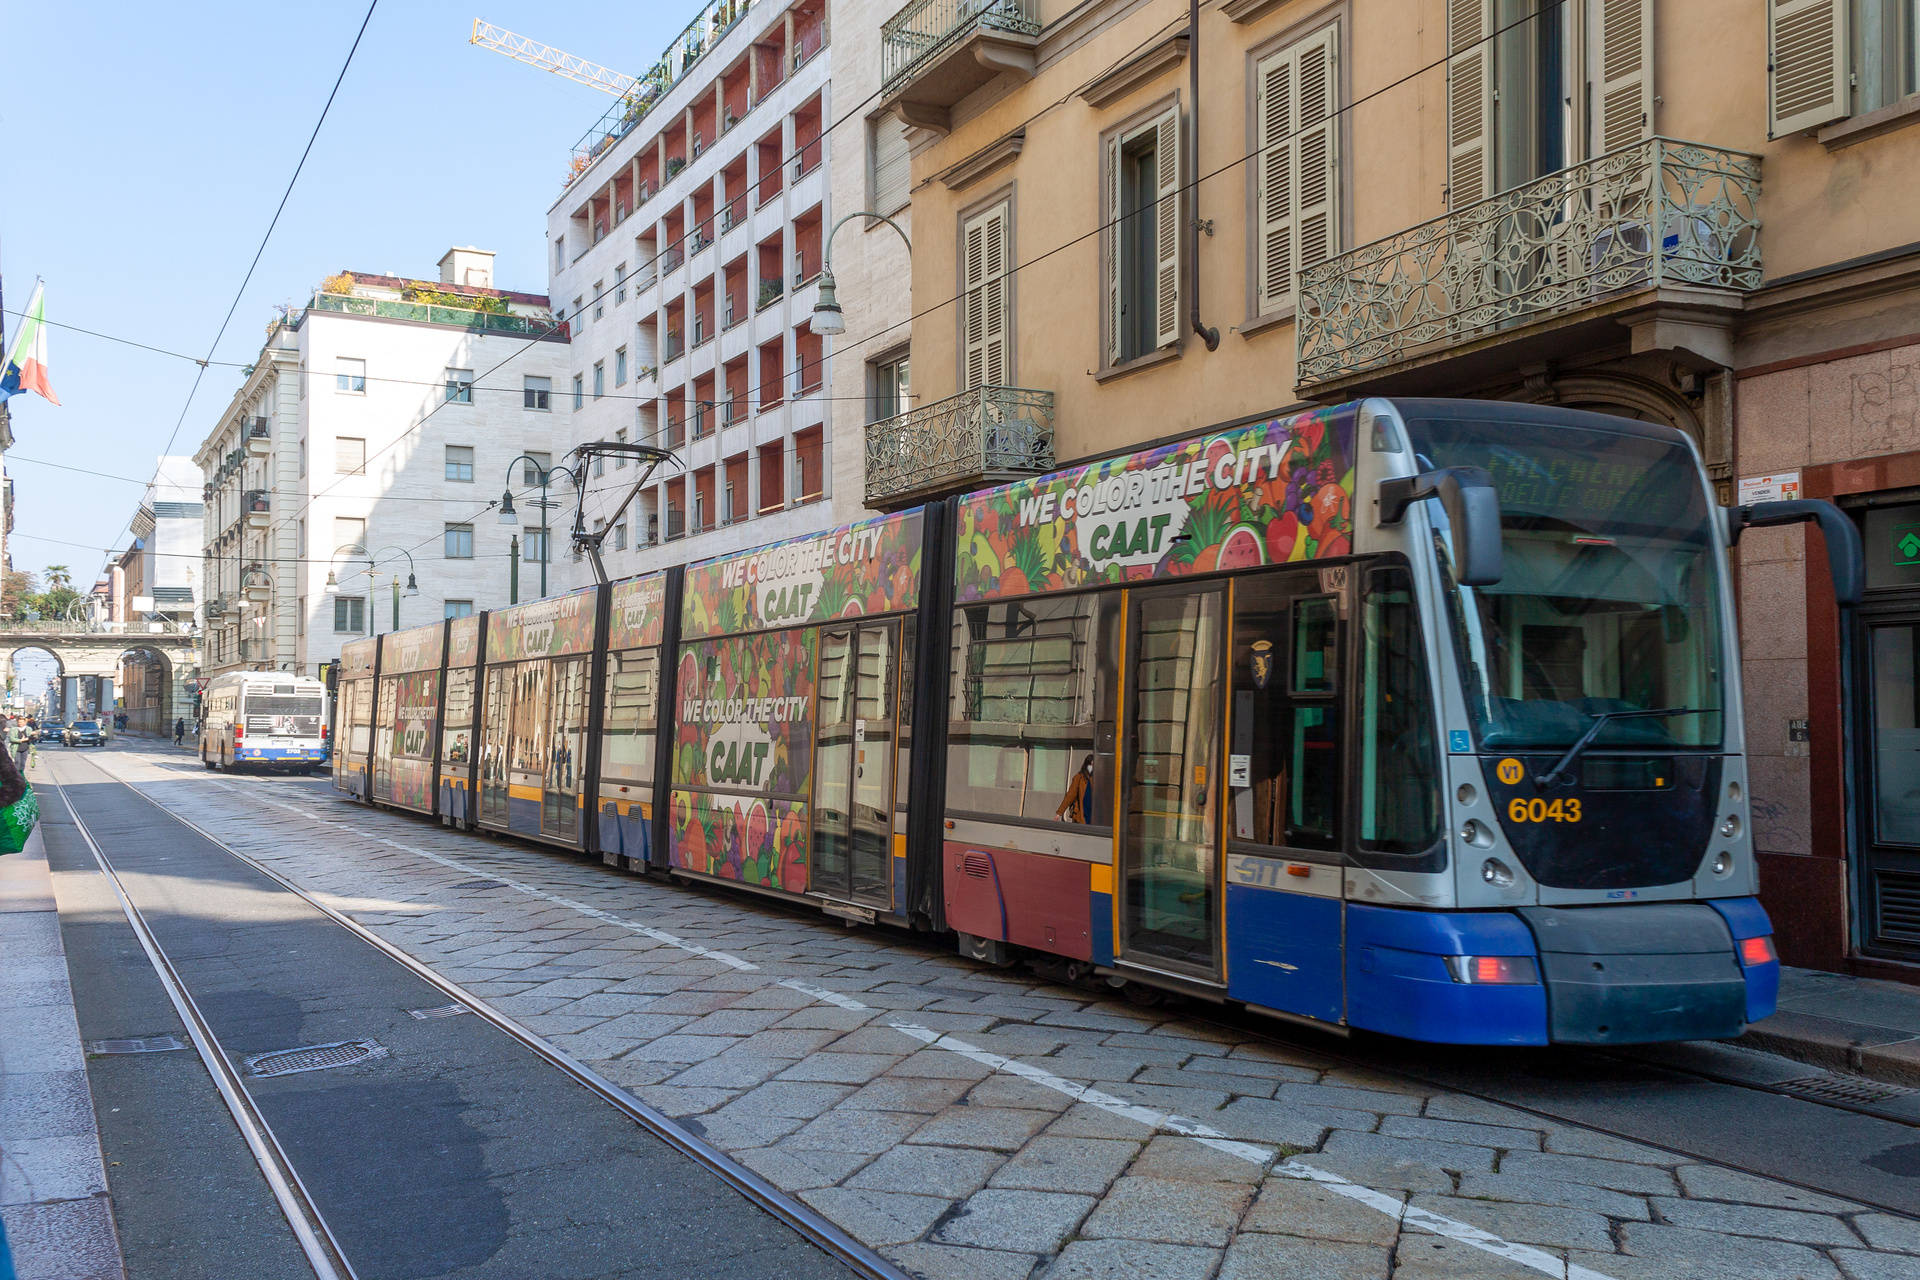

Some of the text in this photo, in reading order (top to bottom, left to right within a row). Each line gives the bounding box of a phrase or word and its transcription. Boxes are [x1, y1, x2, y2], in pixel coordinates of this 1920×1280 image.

[1018, 439, 1292, 527] WE COLOR THE CITY
[1488, 454, 1647, 487] FALCHERA
[1089, 513, 1171, 562] CAAT
[722, 525, 884, 589] WE COLOR THE CITY
[506, 609, 519, 629] WE
[560, 595, 582, 619] CITY
[763, 583, 813, 621] CAAT
[526, 629, 550, 654] CAAT
[683, 695, 808, 725] WE COLOR THE CITY
[710, 740, 769, 786] CAAT
[1501, 765, 1518, 780] V1
[1508, 797, 1583, 823] 6043
[1234, 856, 1284, 887] GTT
